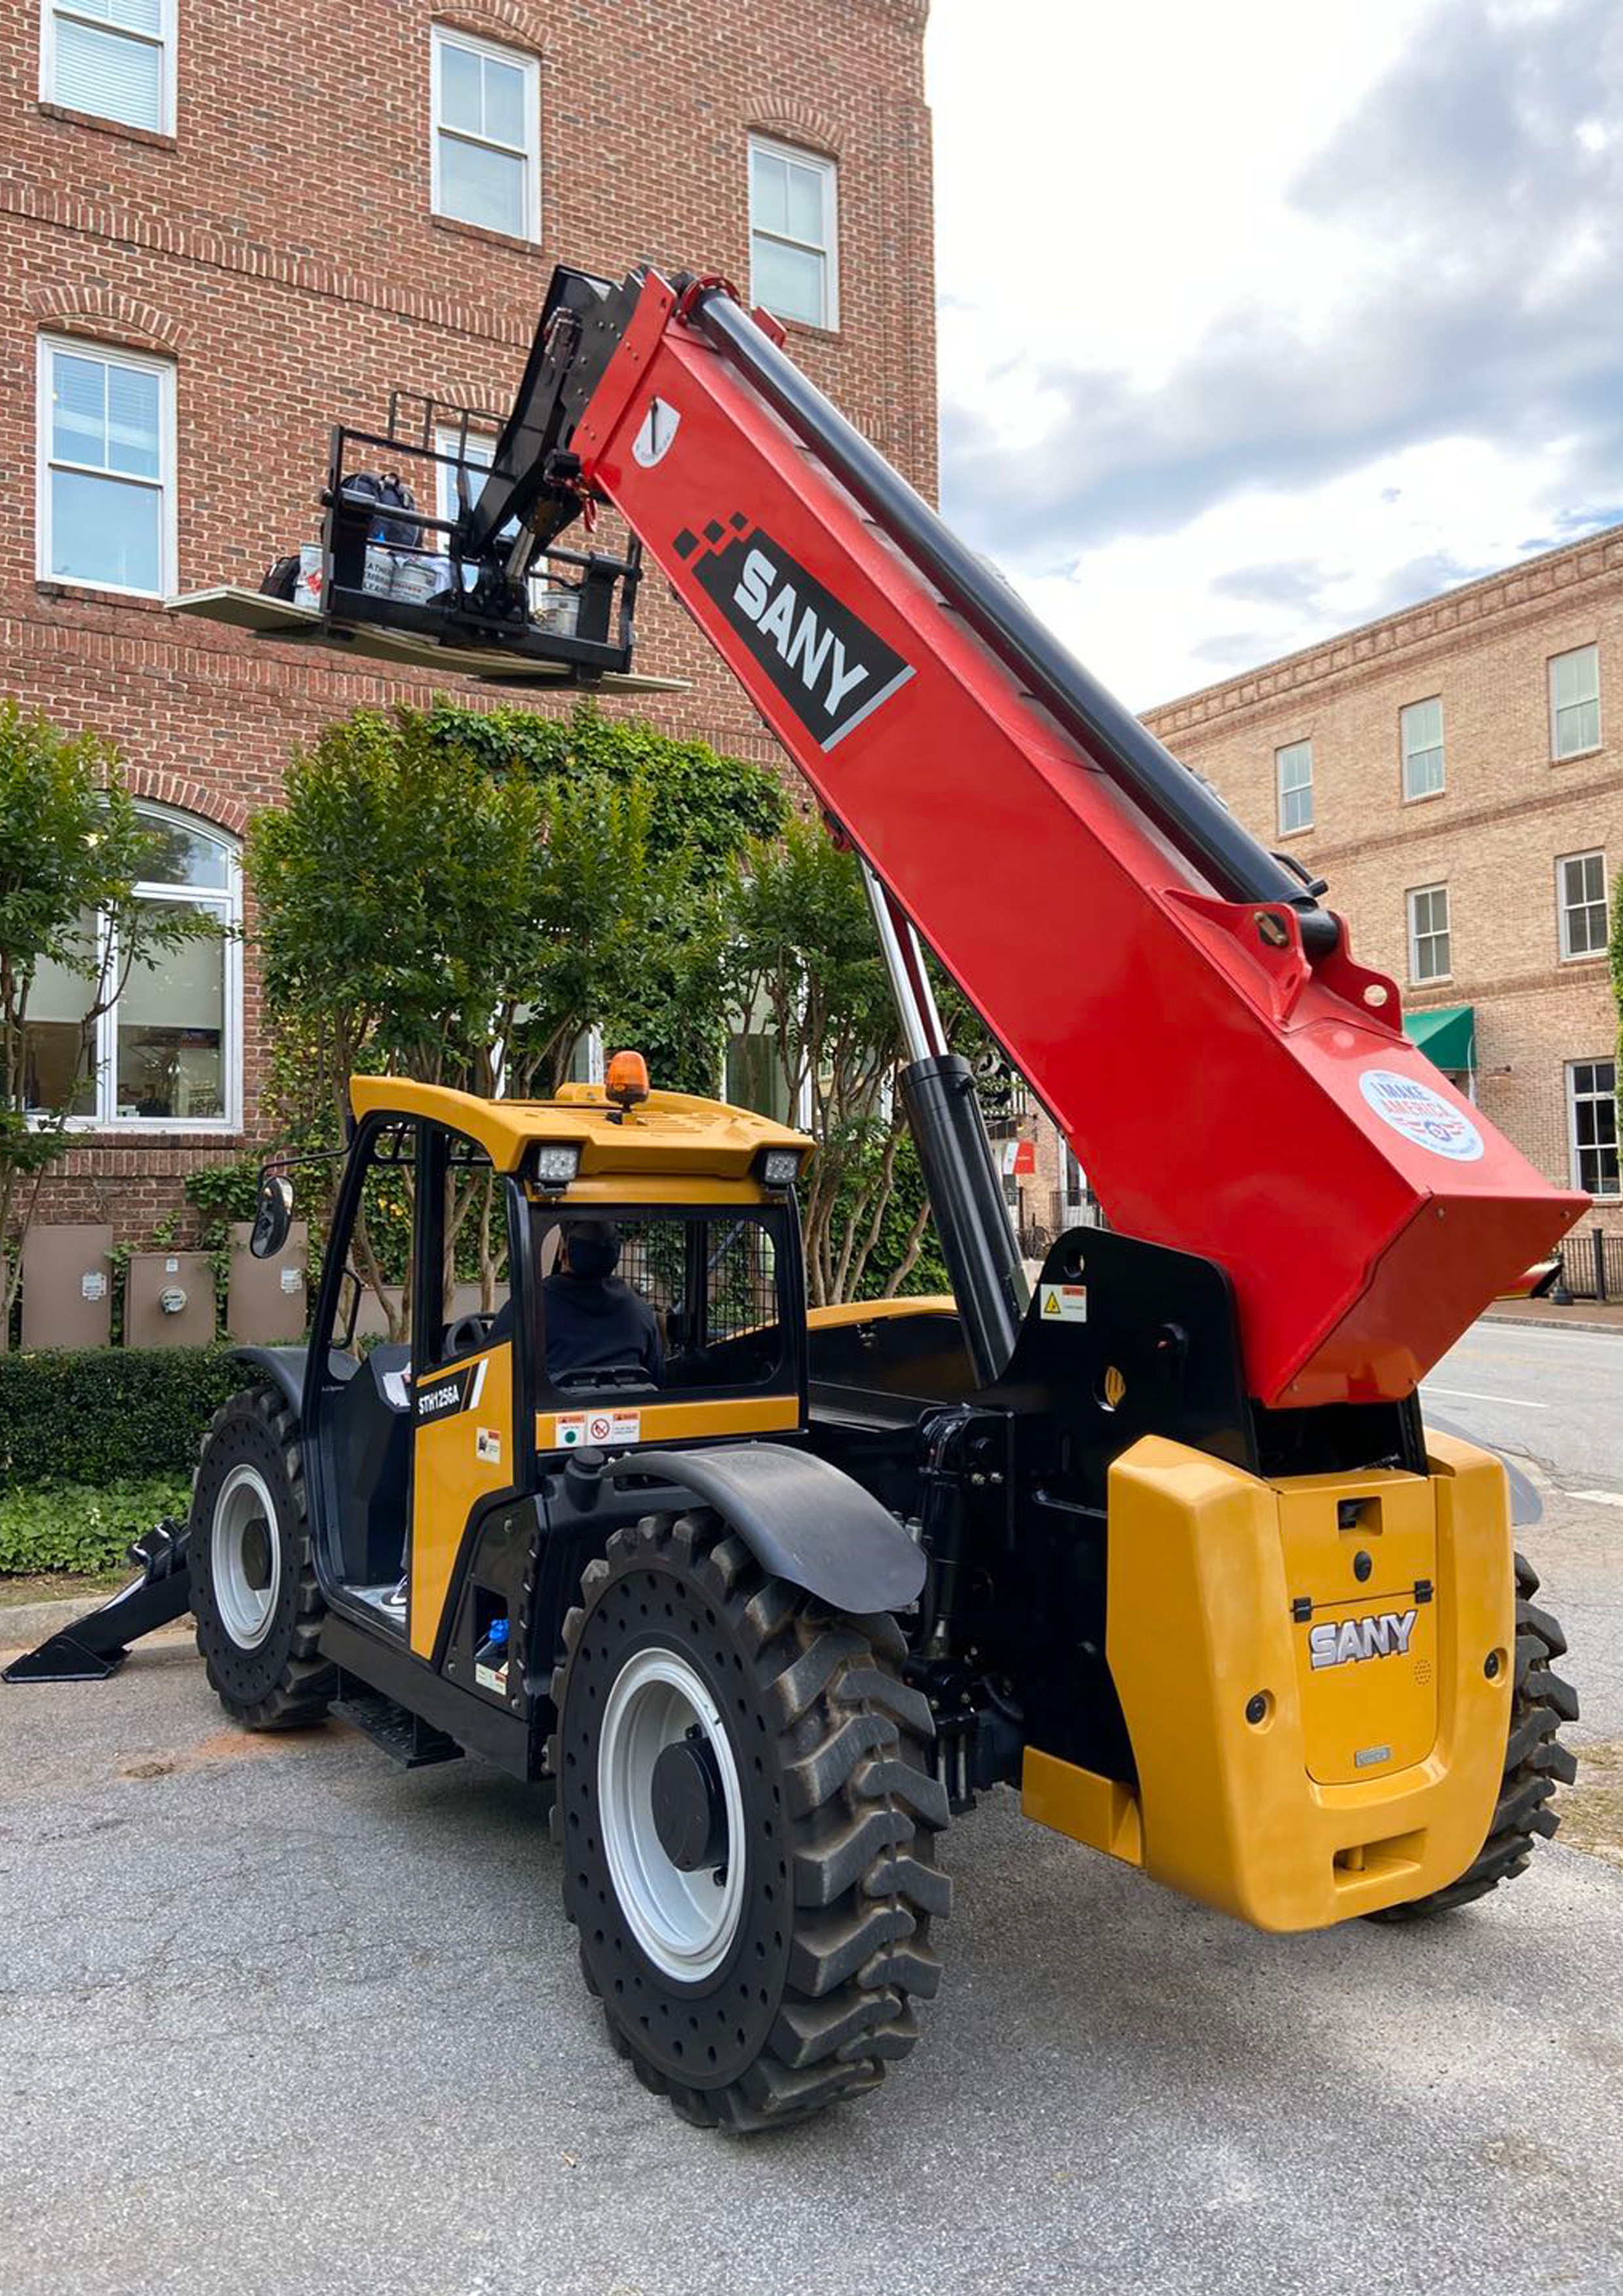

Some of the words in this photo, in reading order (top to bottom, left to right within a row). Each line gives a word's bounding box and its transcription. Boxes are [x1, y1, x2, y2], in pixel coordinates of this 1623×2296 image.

[733, 548, 869, 716] SANY
[1377, 1083, 1430, 1101] MAKE
[1381, 1100, 1458, 1118] AMERICA
[419, 1385, 459, 1414] STH1256A
[1309, 1610, 1418, 1670] SANY
